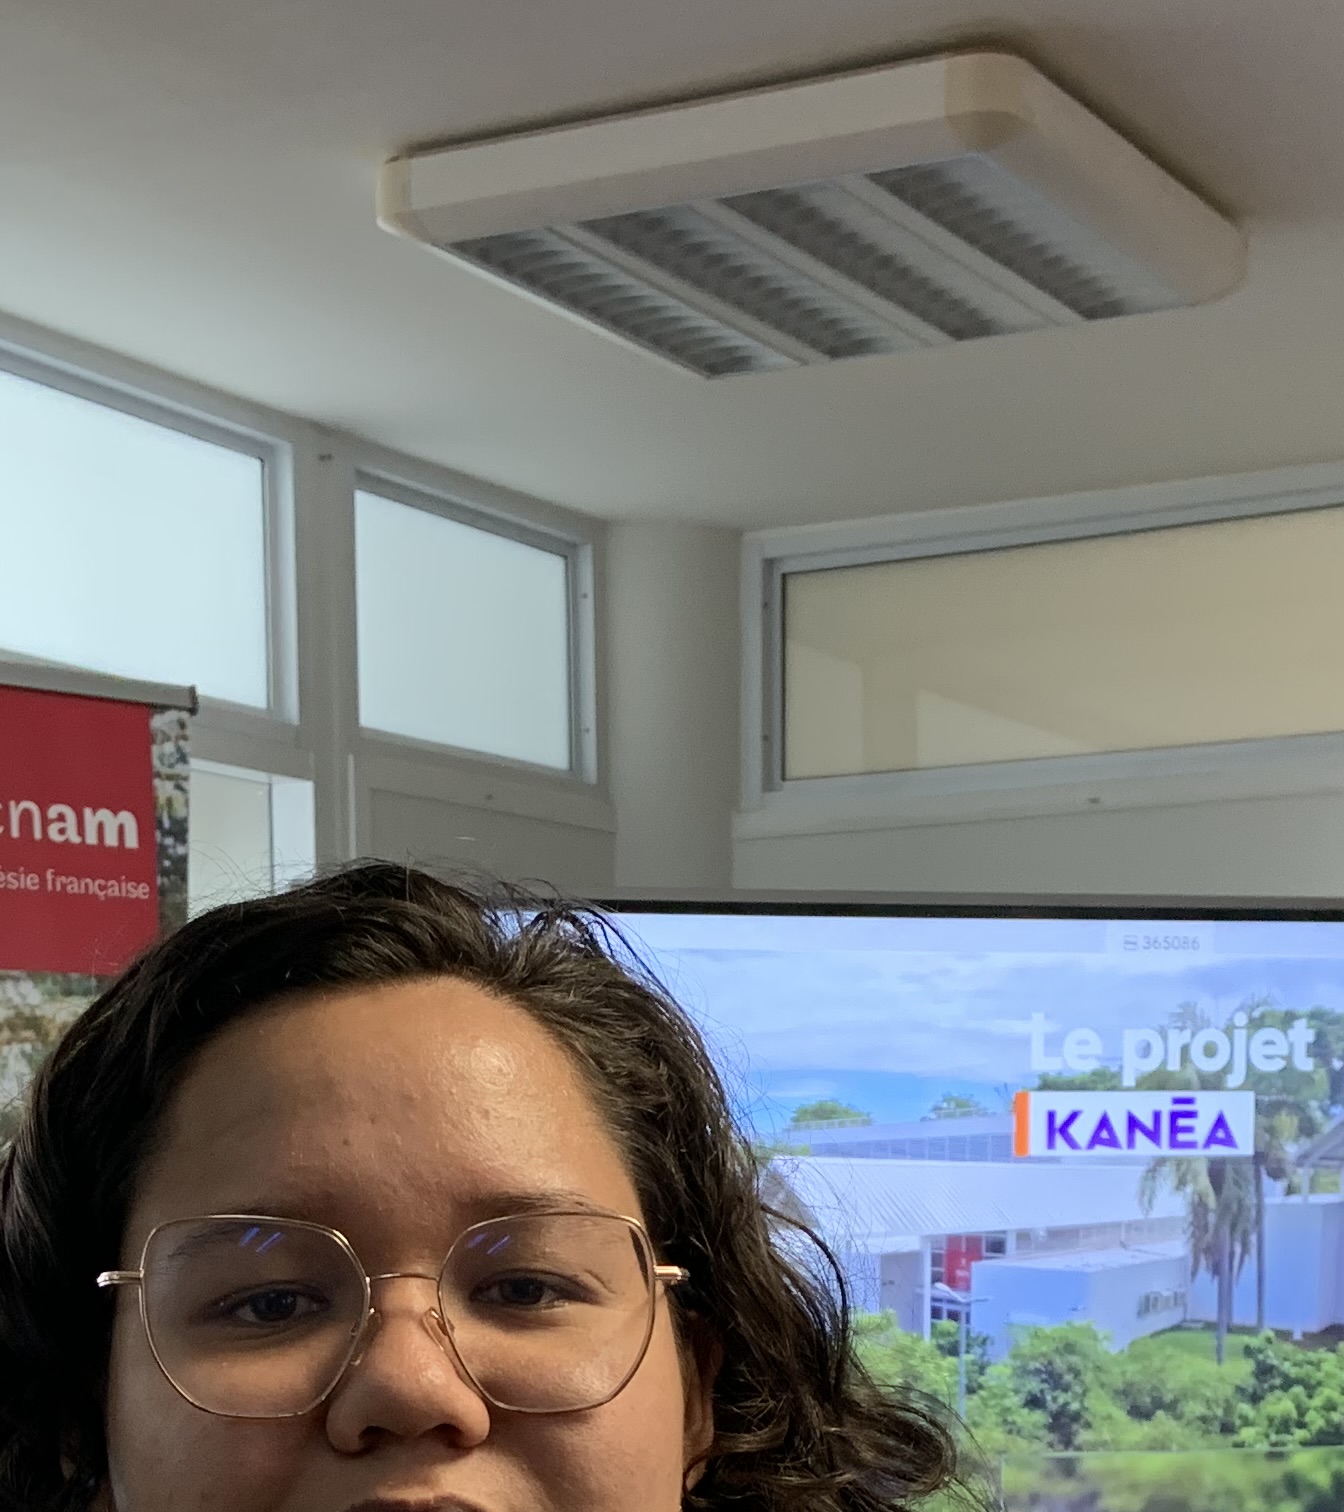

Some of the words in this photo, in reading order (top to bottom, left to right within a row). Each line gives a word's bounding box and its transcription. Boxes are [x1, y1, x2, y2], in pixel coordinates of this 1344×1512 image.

[45, 867, 151, 900] française
[1029, 1011, 1104, 1073] Le
[1121, 1010, 1316, 1090] projet
